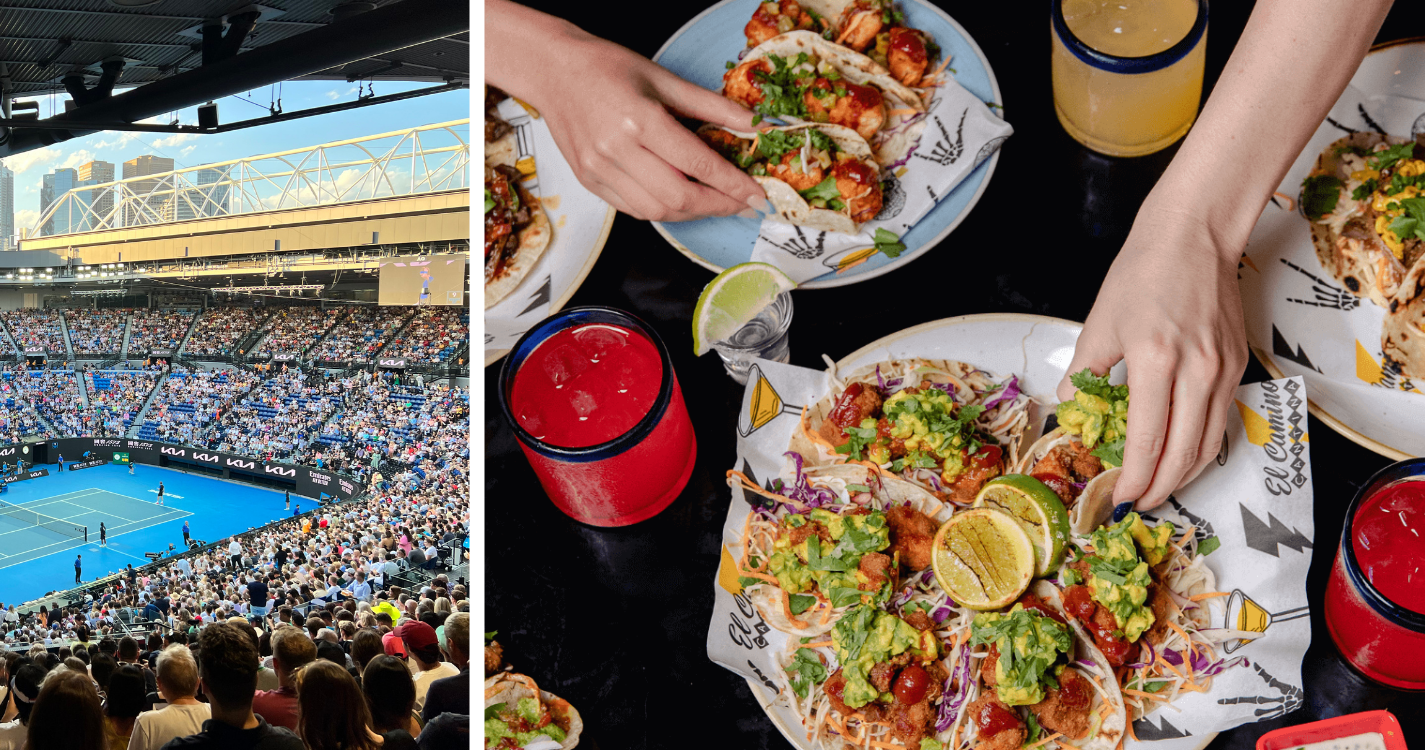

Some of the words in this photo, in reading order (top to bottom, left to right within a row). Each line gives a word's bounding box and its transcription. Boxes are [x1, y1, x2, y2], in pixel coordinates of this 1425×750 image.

[1260, 380, 1288, 463] Camino
[1286, 380, 1305, 487] CANTINA
[161, 446, 185, 457] KIA
[193, 452, 218, 463] KIA
[226, 458, 254, 469] KIA
[265, 465, 295, 477] KIA
[1263, 466, 1292, 496] El
[729, 611, 753, 650] El
